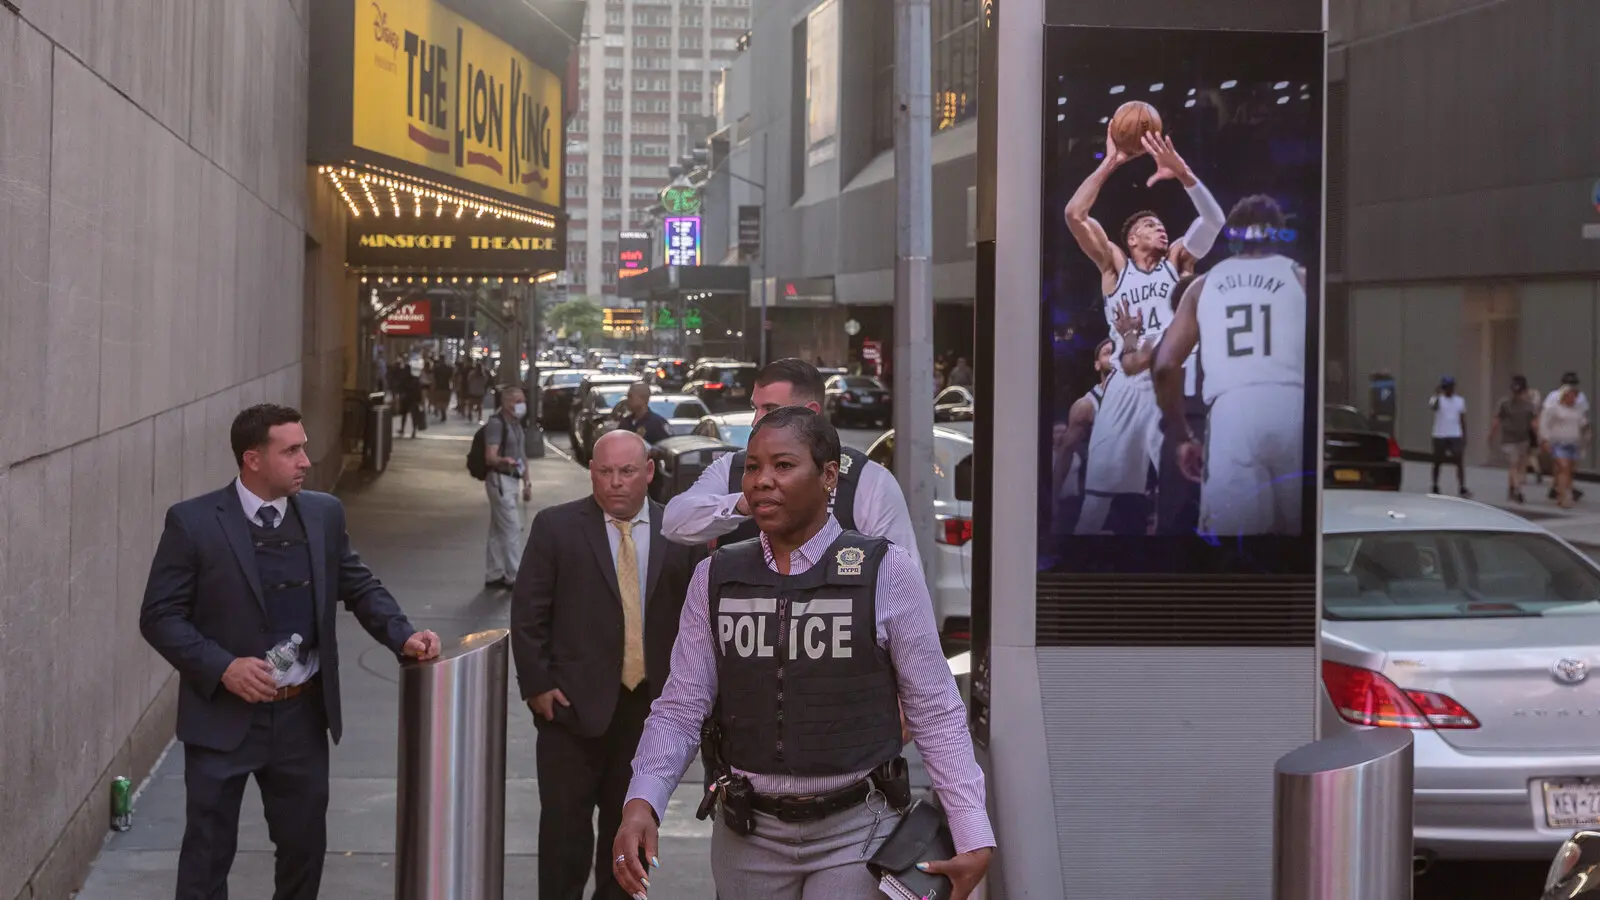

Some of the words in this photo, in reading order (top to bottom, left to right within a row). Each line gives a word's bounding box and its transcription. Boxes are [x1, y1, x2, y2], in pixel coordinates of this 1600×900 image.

[404, 29, 448, 130] THE
[455, 23, 504, 168] LION
[508, 56, 550, 185] KING
[359, 234, 456, 250] MINSKOFF
[468, 235, 557, 251] THEATRE
[1215, 272, 1286, 295] HOLIDAY
[1225, 303, 1274, 359] 21
[718, 616, 852, 660] POLICE
